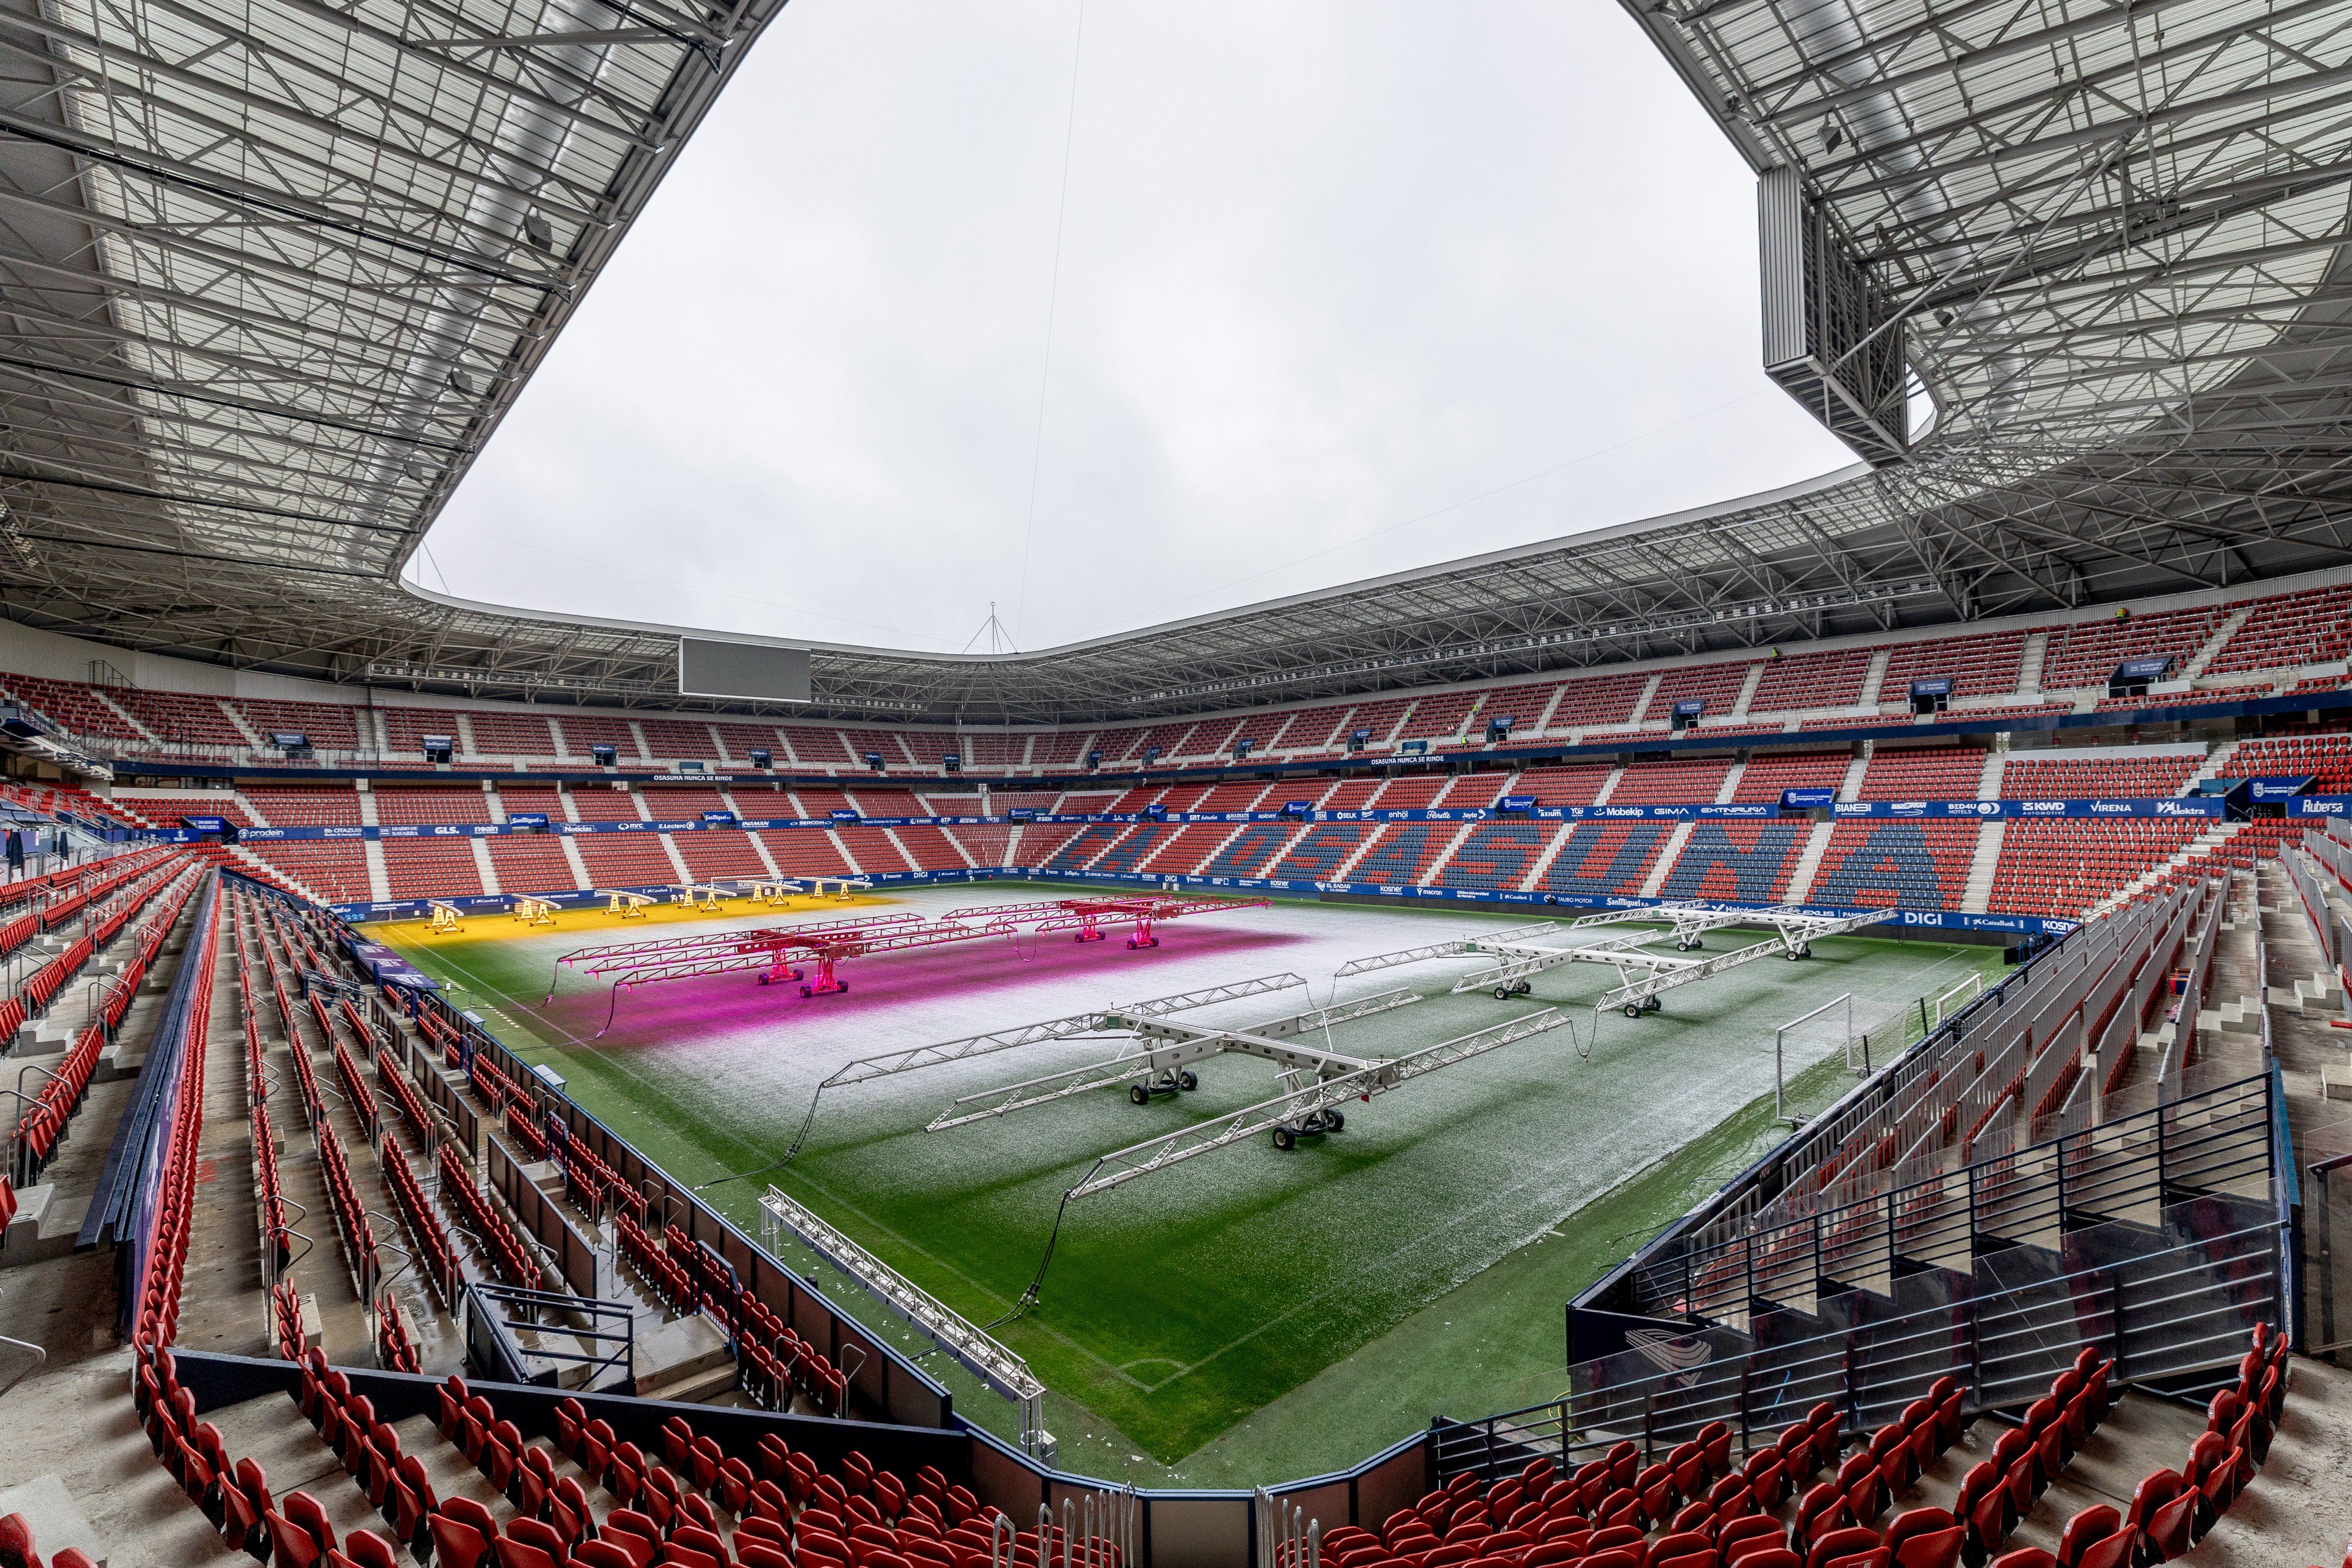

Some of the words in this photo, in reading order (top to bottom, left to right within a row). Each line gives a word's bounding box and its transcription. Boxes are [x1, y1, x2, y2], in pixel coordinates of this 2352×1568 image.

[2171, 804, 2205, 815] elektra
[2303, 800, 2343, 812] Rubersa
[1426, 811, 1450, 819] Florette
[1607, 807, 1643, 817] Mobekip
[1606, 898, 1640, 908] SanMiguel
[1904, 912, 1942, 926] DIGI
